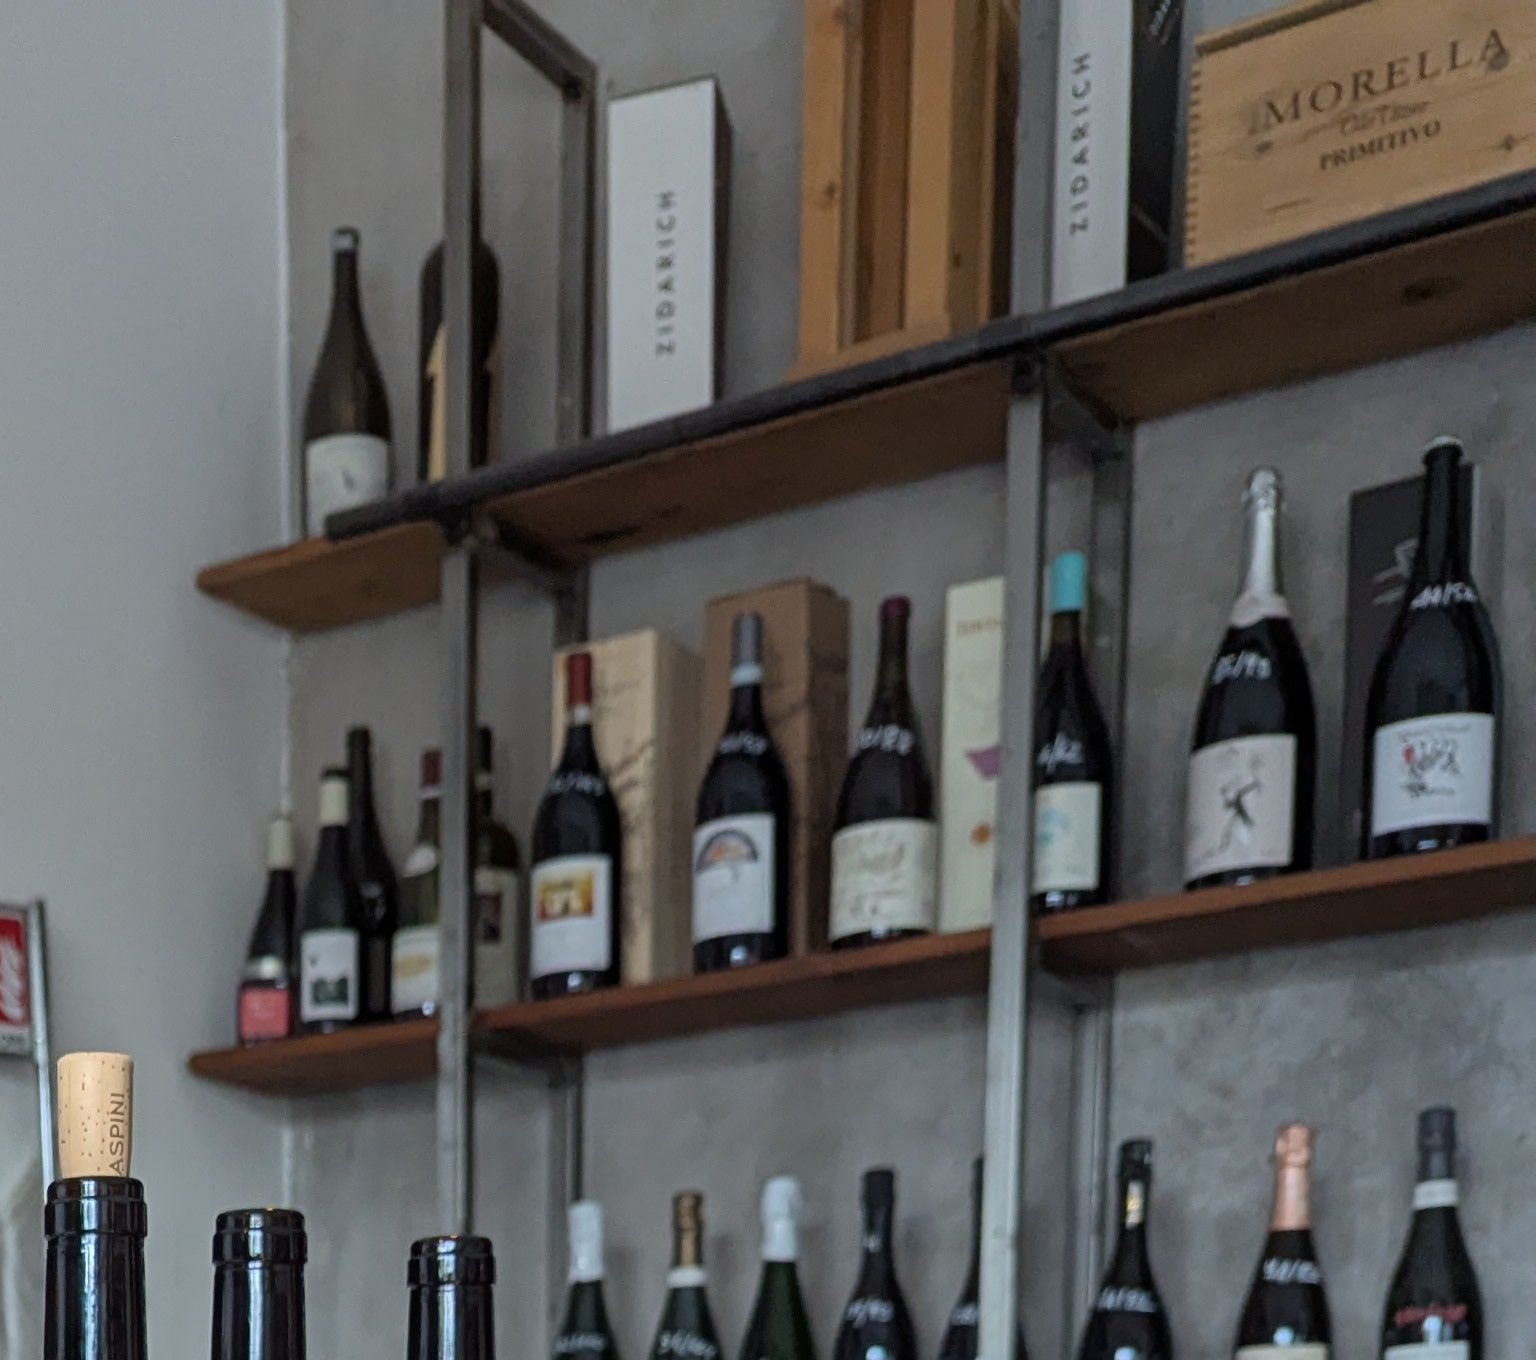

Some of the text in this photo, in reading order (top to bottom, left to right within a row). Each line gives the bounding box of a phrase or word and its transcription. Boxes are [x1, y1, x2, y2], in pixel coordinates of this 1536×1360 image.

[1069, 52, 1092, 236] ZIDARICH
[1319, 119, 1442, 171] PRIMITIVO
[655, 191, 677, 357] ZIDARICH
[108, 1092, 126, 1177] ASPINI
